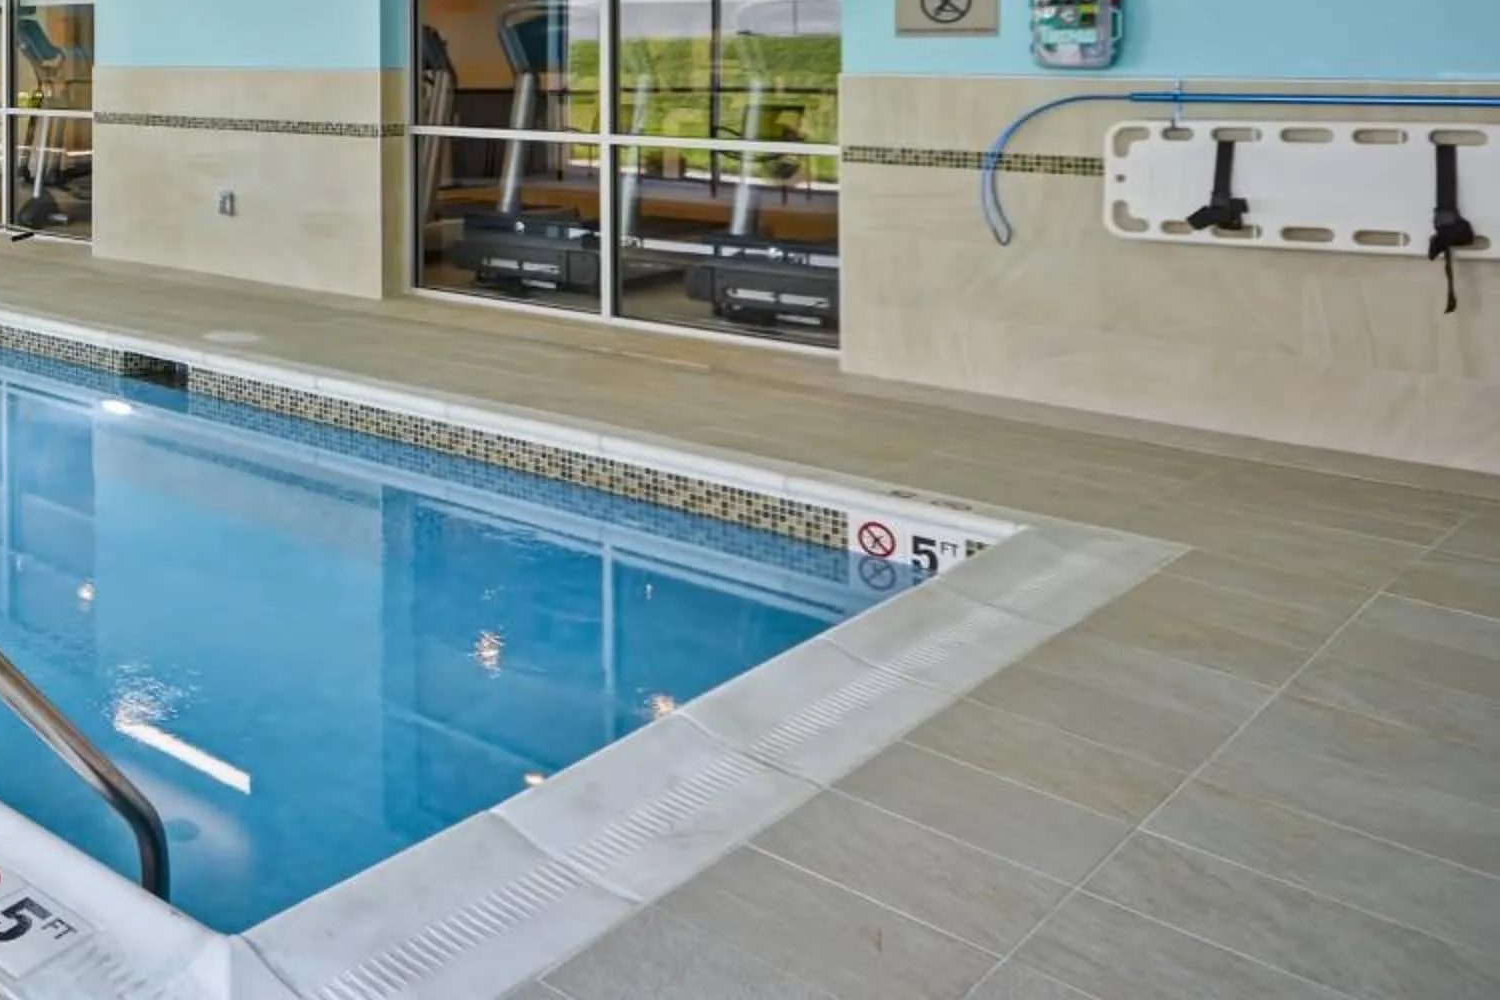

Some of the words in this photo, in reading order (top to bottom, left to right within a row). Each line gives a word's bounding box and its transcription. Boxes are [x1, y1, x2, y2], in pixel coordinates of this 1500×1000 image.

[912, 536, 938, 574] 5
[940, 541, 960, 557] FT
[41, 917, 78, 940] FT
